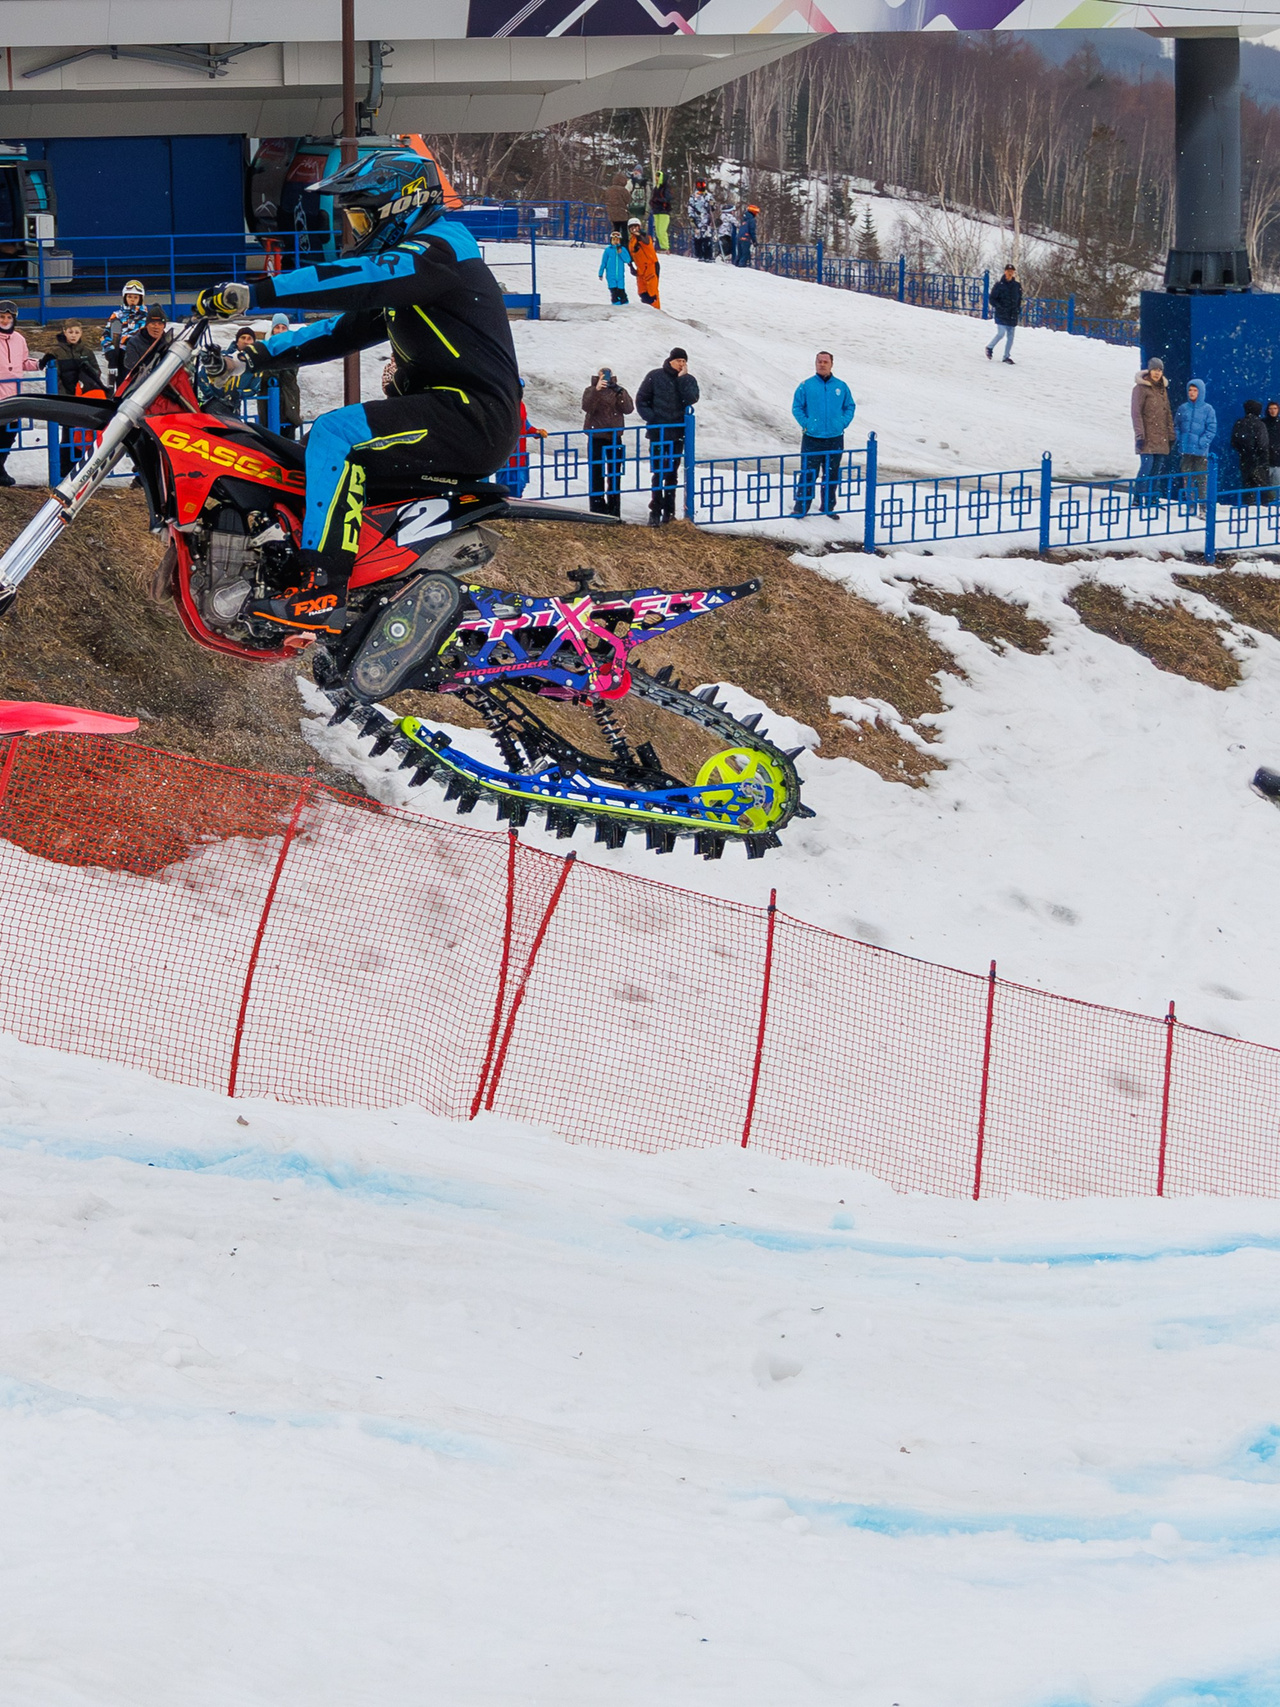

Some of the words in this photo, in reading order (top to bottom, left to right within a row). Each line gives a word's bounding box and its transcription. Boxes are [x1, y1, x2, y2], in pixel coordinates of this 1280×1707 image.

[378, 190, 443, 219] 100%
[160, 429, 305, 489] GASGAS
[421, 475, 458, 485] GASGAS
[341, 462, 366, 554] FXR
[396, 498, 452, 547] 2
[291, 594, 338, 616] FXR
[308, 606, 334, 617] RACING
[454, 659, 549, 679] SNOWRIDER
